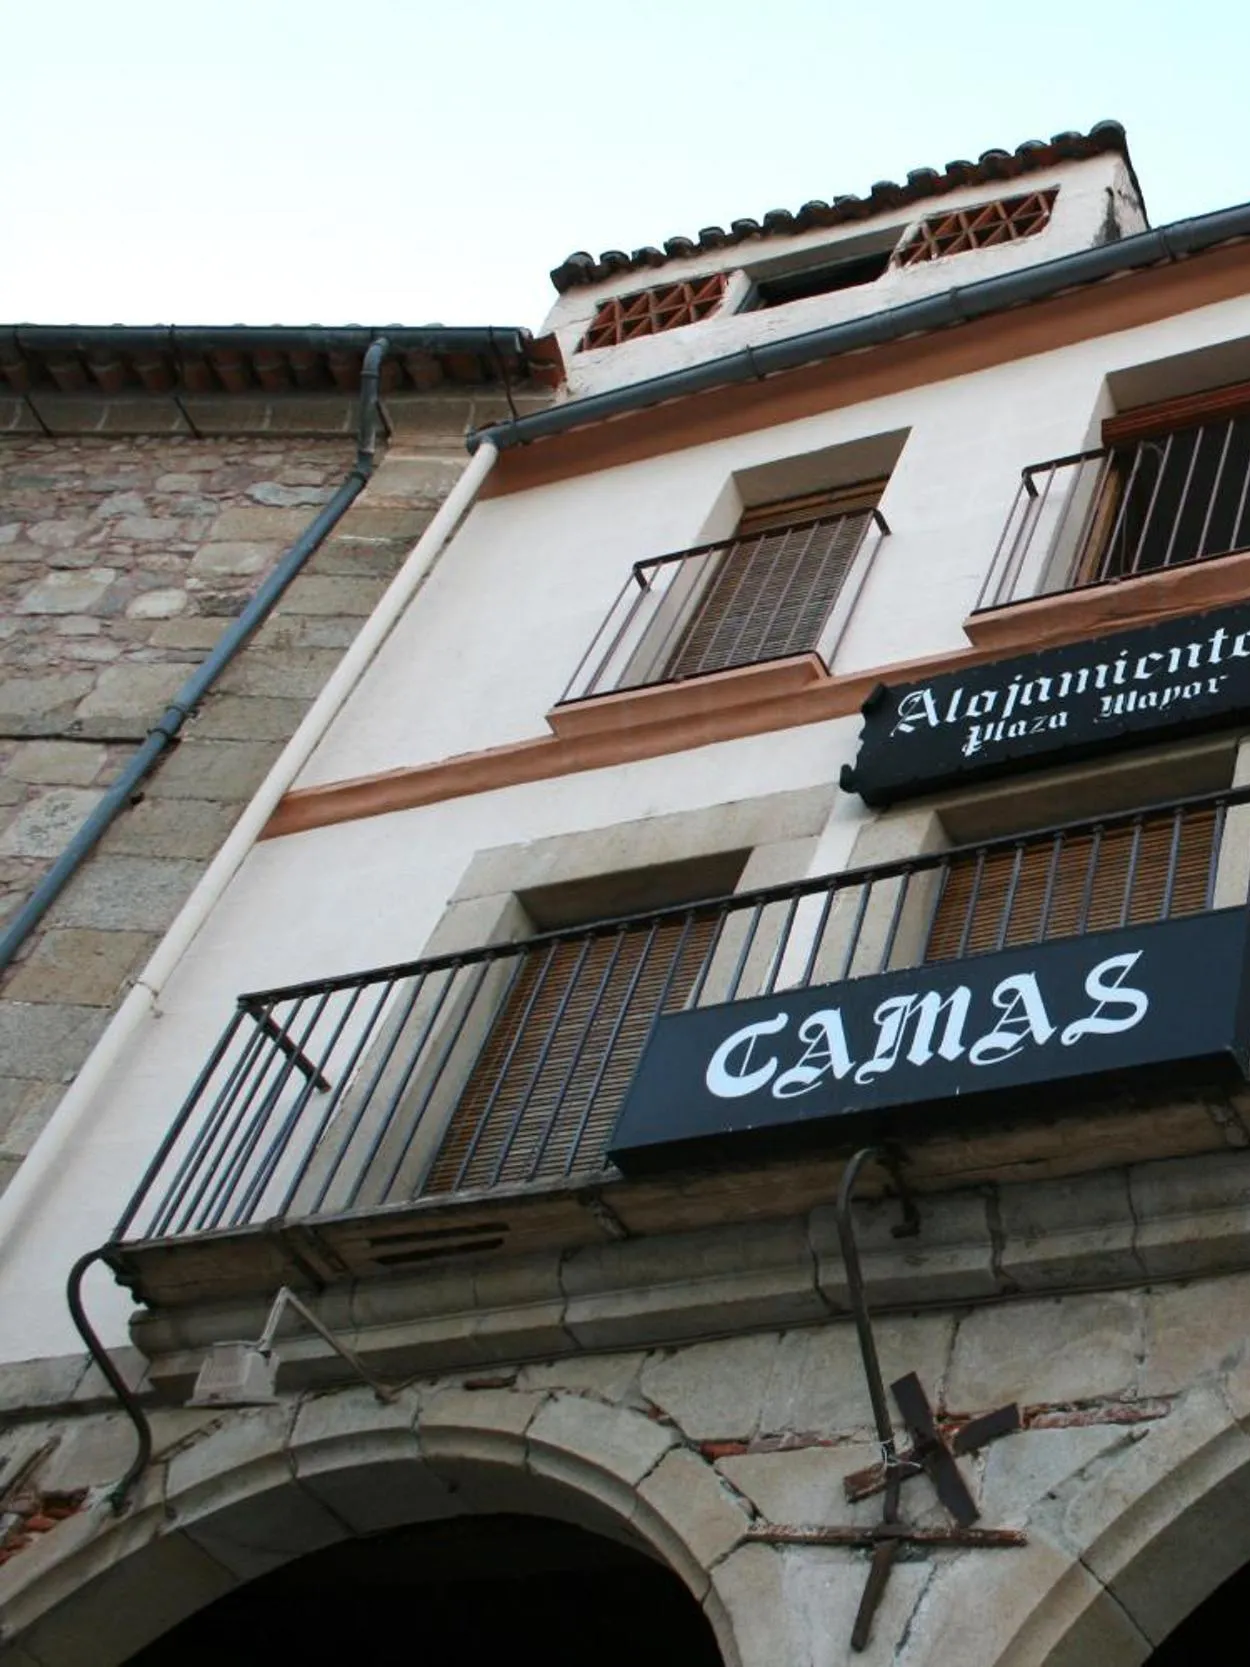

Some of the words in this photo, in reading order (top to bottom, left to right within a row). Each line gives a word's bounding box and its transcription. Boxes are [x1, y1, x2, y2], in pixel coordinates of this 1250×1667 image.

[961, 710, 1069, 757] Plaza
[1095, 675, 1229, 724] Mayor
[705, 949, 1150, 1099] CAMAS
